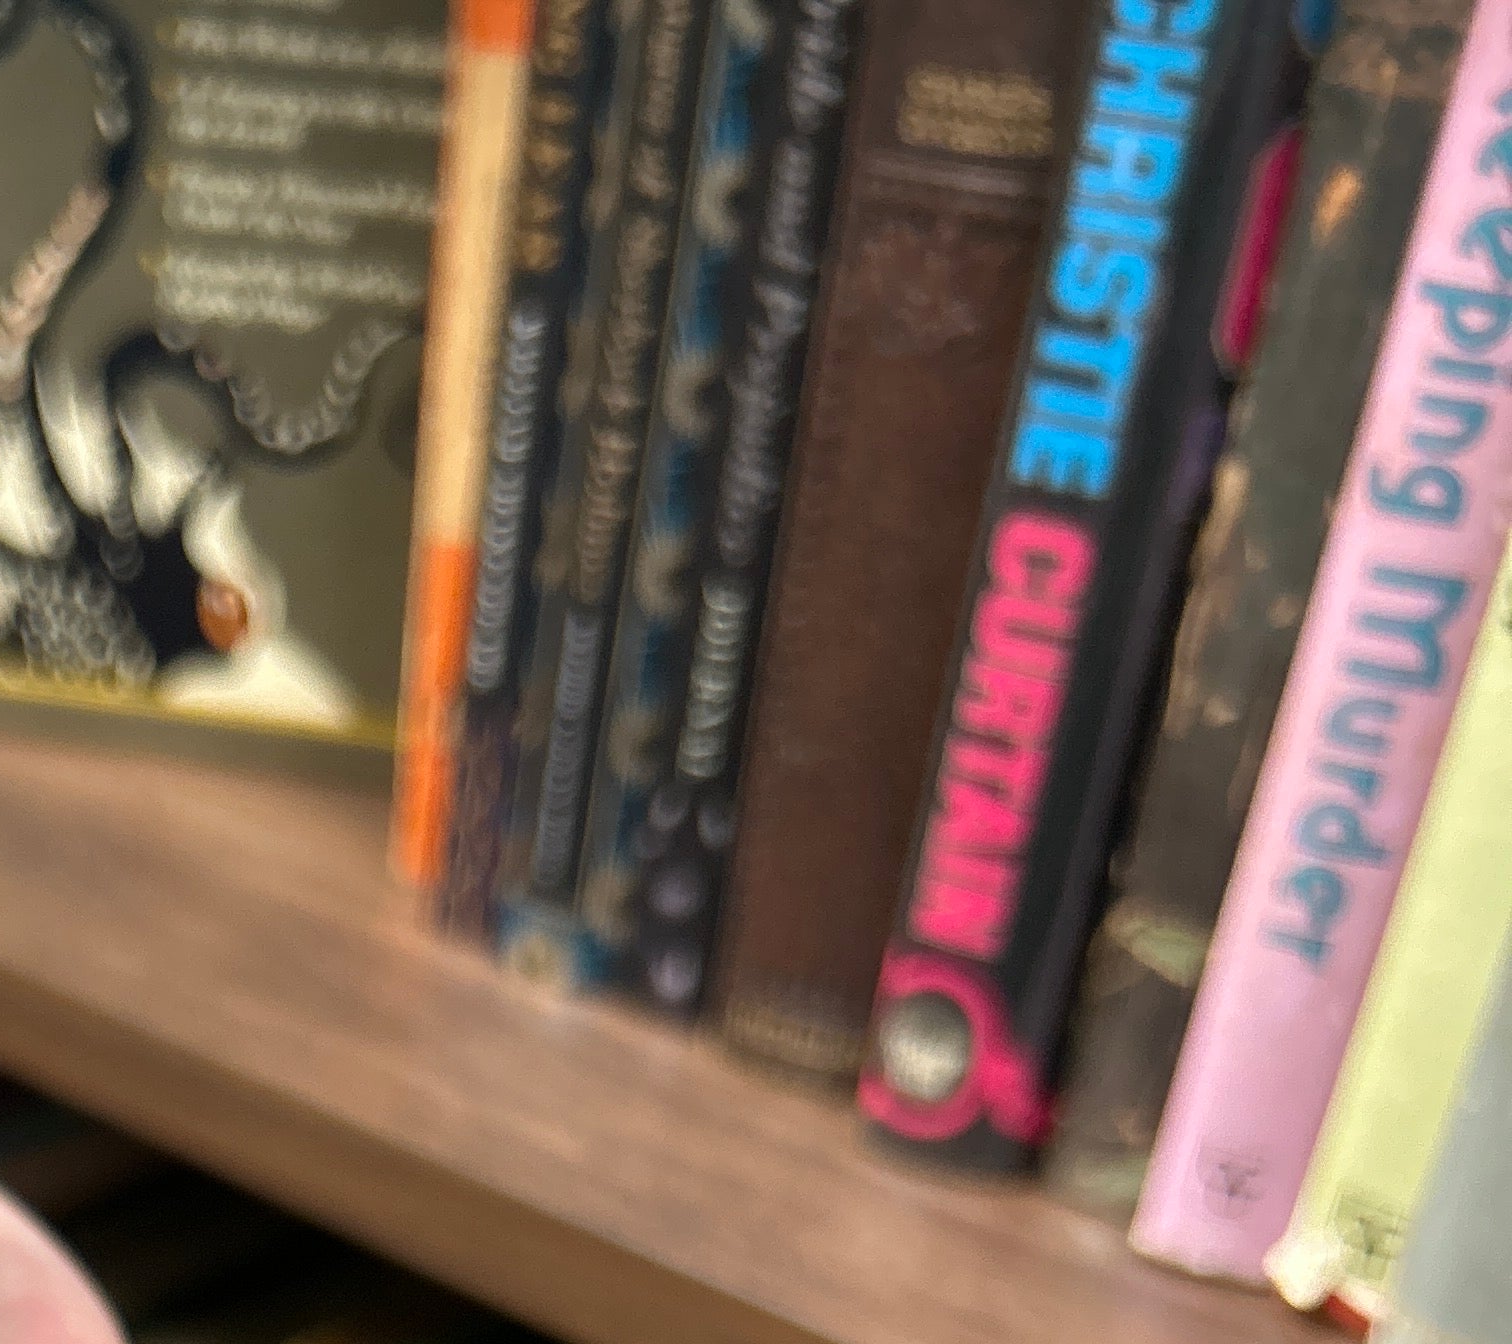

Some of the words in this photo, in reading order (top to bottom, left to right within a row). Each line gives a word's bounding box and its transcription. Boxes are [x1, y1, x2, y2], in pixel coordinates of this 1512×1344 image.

[1368, 88, 1512, 528] eping
[905, 507, 1100, 962] CURTAIN
[1262, 564, 1470, 975] Murder
